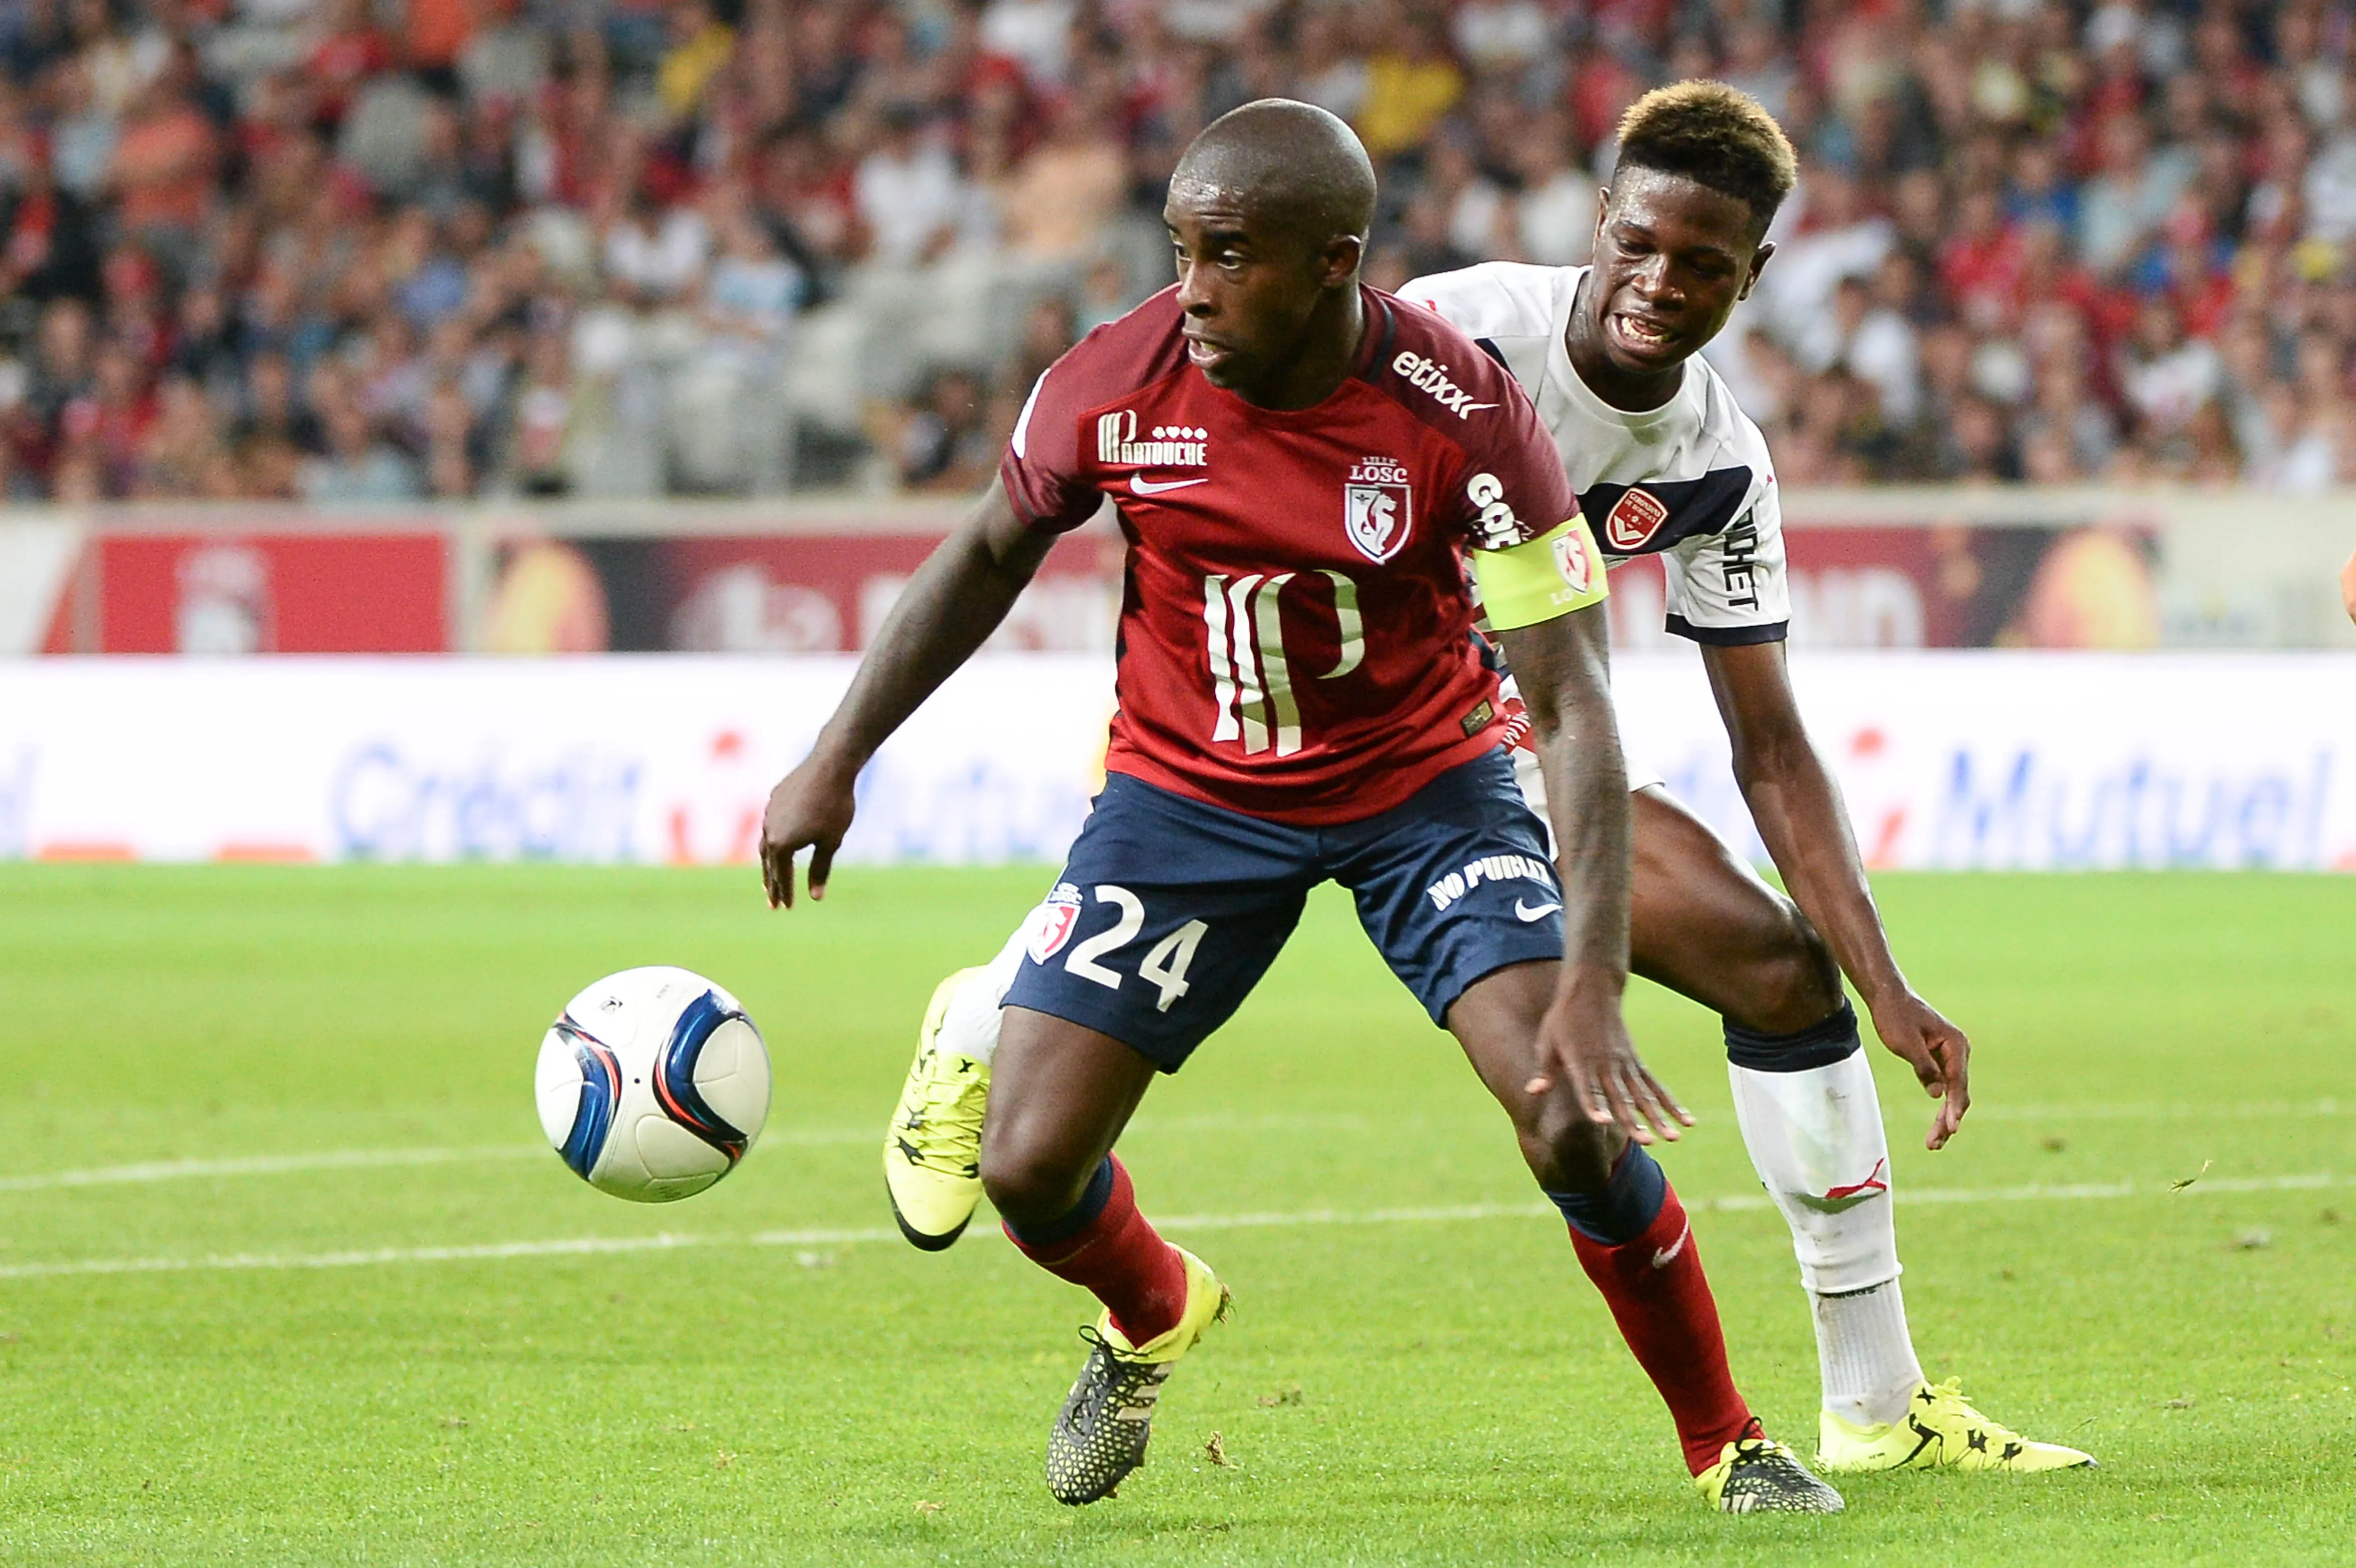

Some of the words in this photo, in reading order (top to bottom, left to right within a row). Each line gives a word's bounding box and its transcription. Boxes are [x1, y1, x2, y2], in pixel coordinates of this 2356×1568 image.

[1393, 351, 1474, 413] etixx
[1349, 465, 1408, 483] LOSC
[1427, 872, 1465, 912] NO
[1064, 885, 1209, 1013] 24
